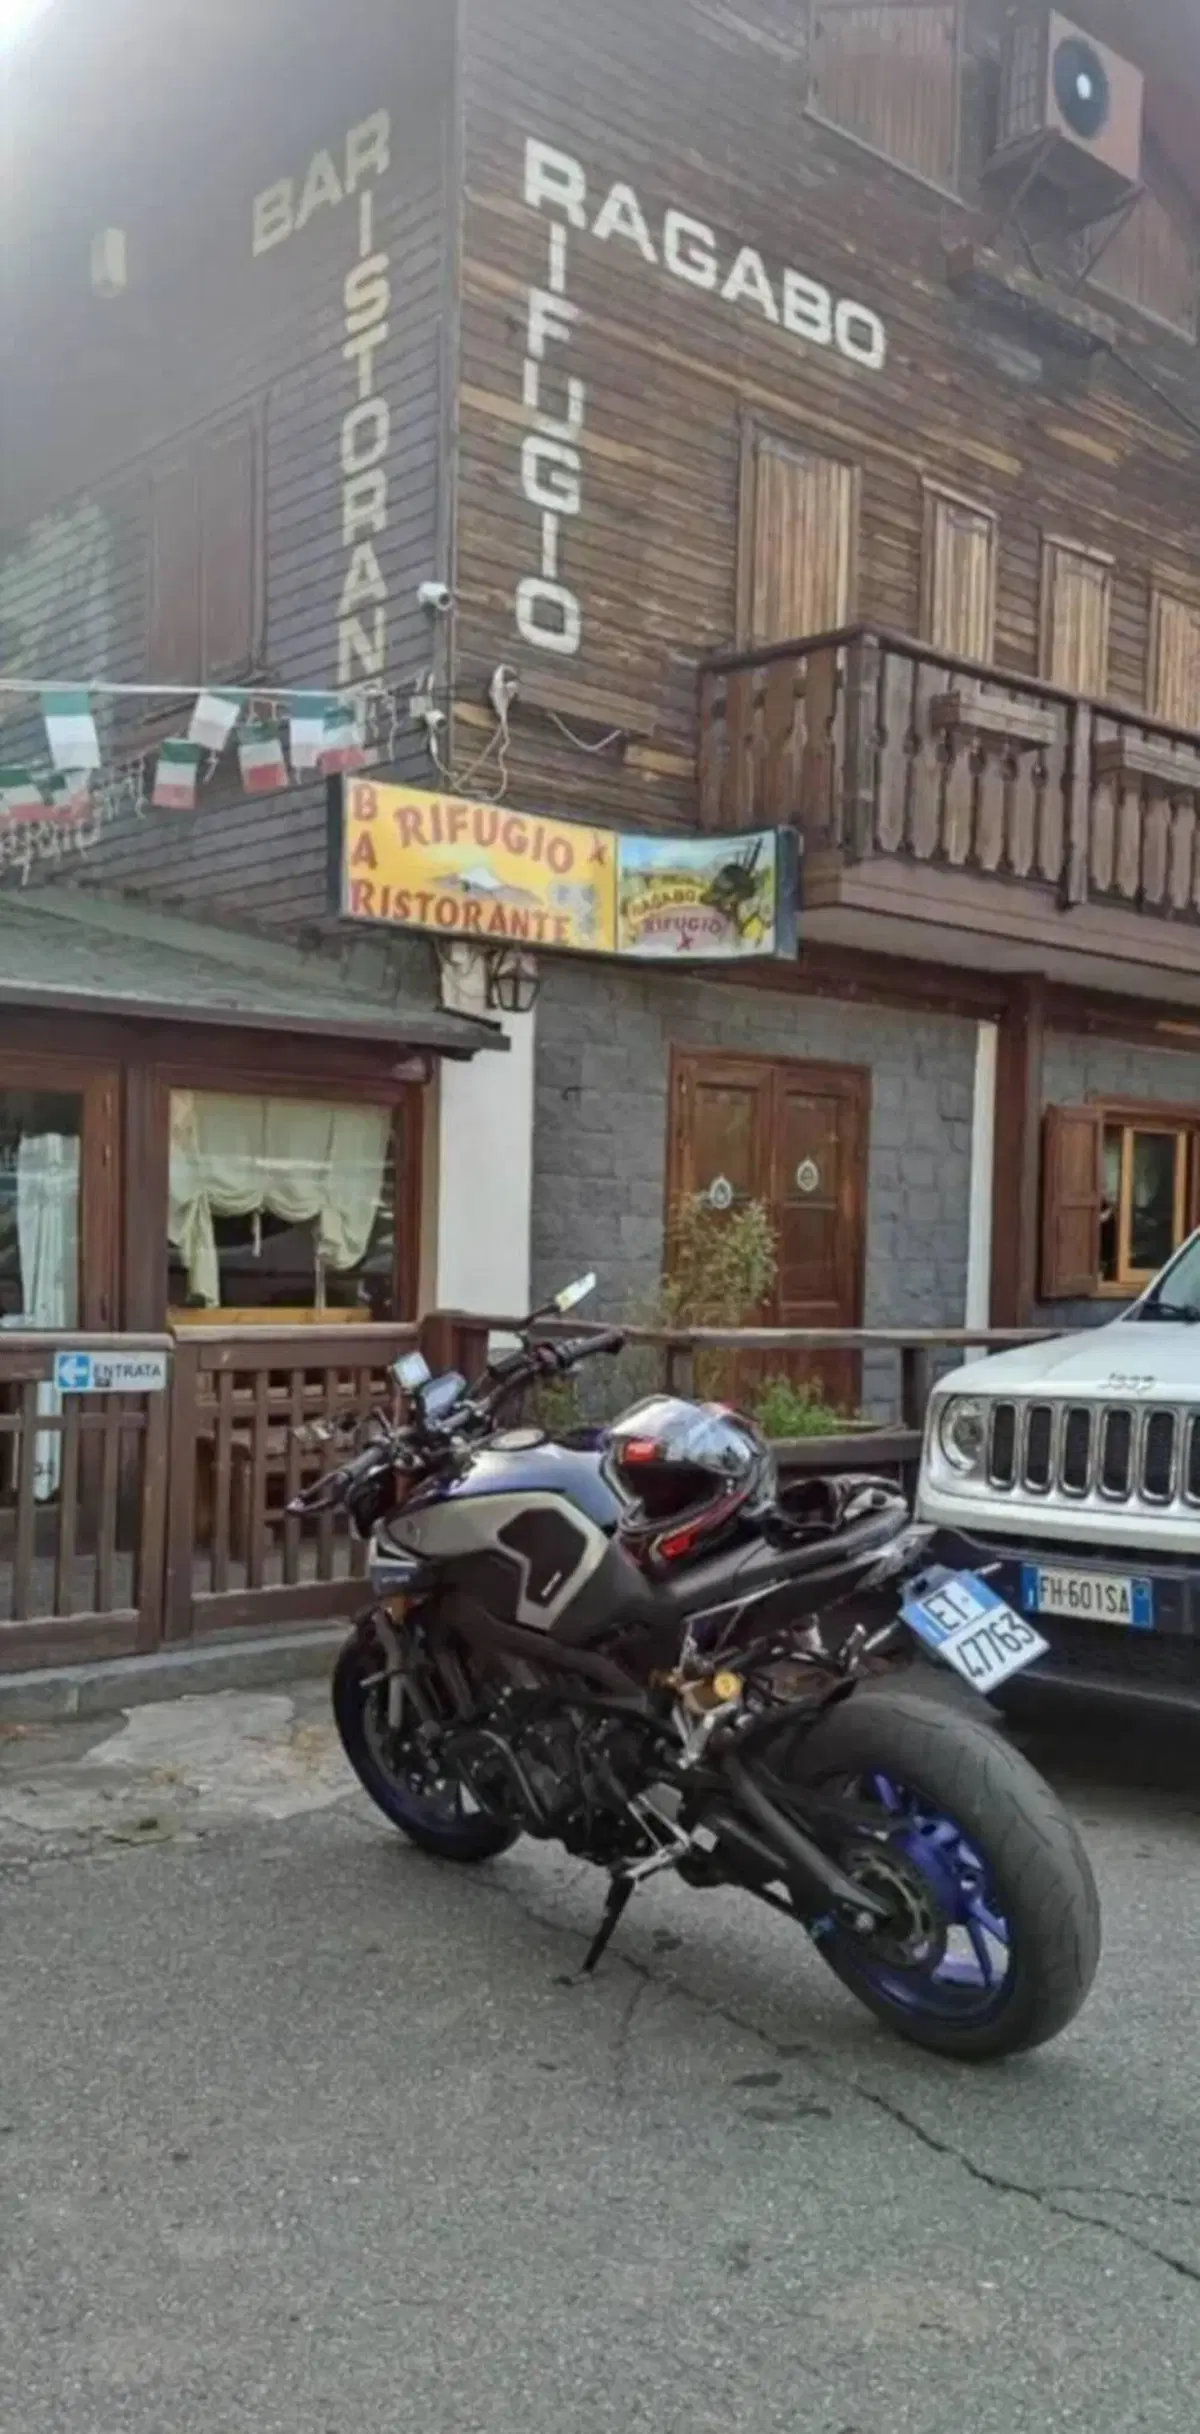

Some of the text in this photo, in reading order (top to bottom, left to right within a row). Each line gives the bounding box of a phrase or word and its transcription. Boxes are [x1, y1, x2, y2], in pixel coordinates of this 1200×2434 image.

[251, 108, 391, 257] BAR
[524, 137, 887, 370] RAGABO
[515, 137, 589, 655] RIFUGIO
[351, 783, 378, 916] BAR
[393, 801, 574, 874] RIFUGIO
[350, 879, 572, 945] RISTORANTE
[644, 914, 722, 936] RIFUGIO
[94, 1362, 161, 1379] ENTRATA
[922, 1590, 968, 1632] ET
[956, 1611, 1035, 1678] 47763
